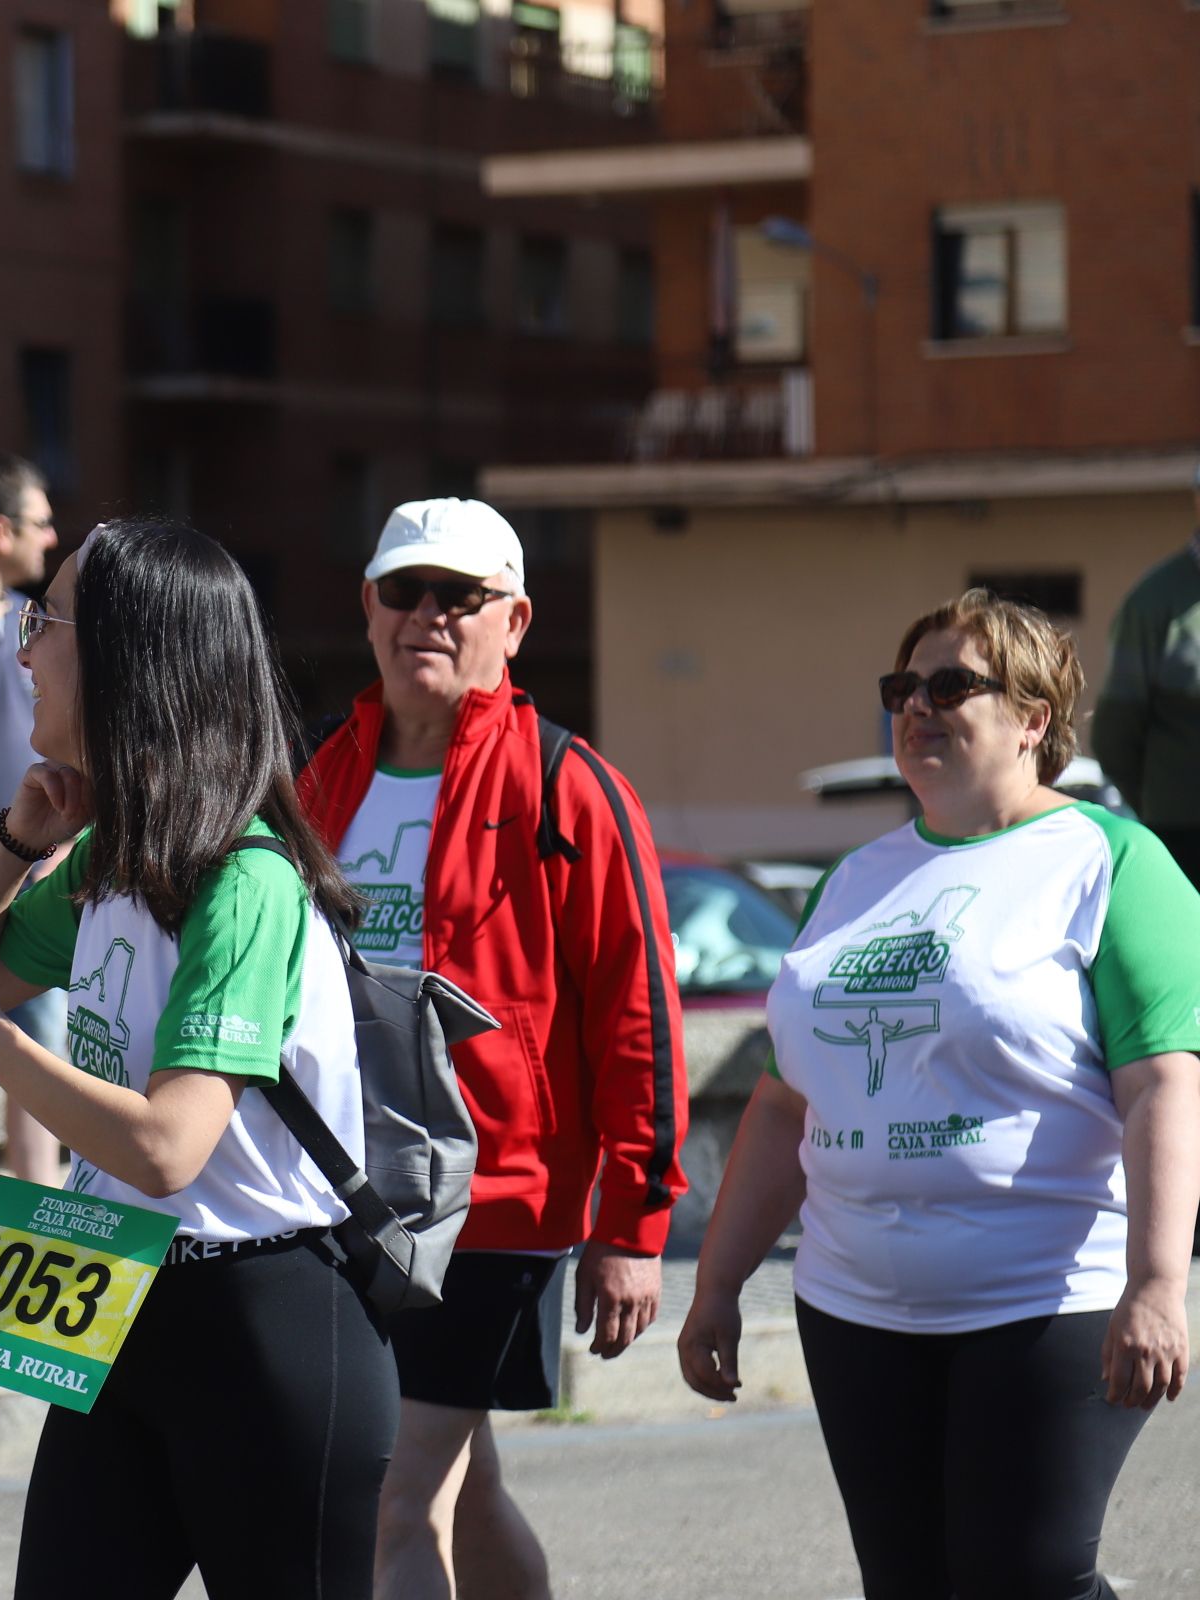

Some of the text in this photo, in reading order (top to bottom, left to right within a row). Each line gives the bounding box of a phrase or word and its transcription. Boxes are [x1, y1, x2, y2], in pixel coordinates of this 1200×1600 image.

[883, 933, 931, 951] CARRERA
[867, 943, 946, 974] CERCO
[849, 975, 914, 990] DE ZAMORA
[82, 1016, 109, 1047] CARRERA
[180, 1025, 262, 1044] CAJA RURAL
[888, 1130, 986, 1150] CAJA RURAL
[889, 1150, 943, 1160] DE ZAMORA
[27, 1221, 72, 1238] DE ZAMORA
[33, 1209, 114, 1240] CAJA RURAL
[15, 1355, 88, 1394] RURAL
